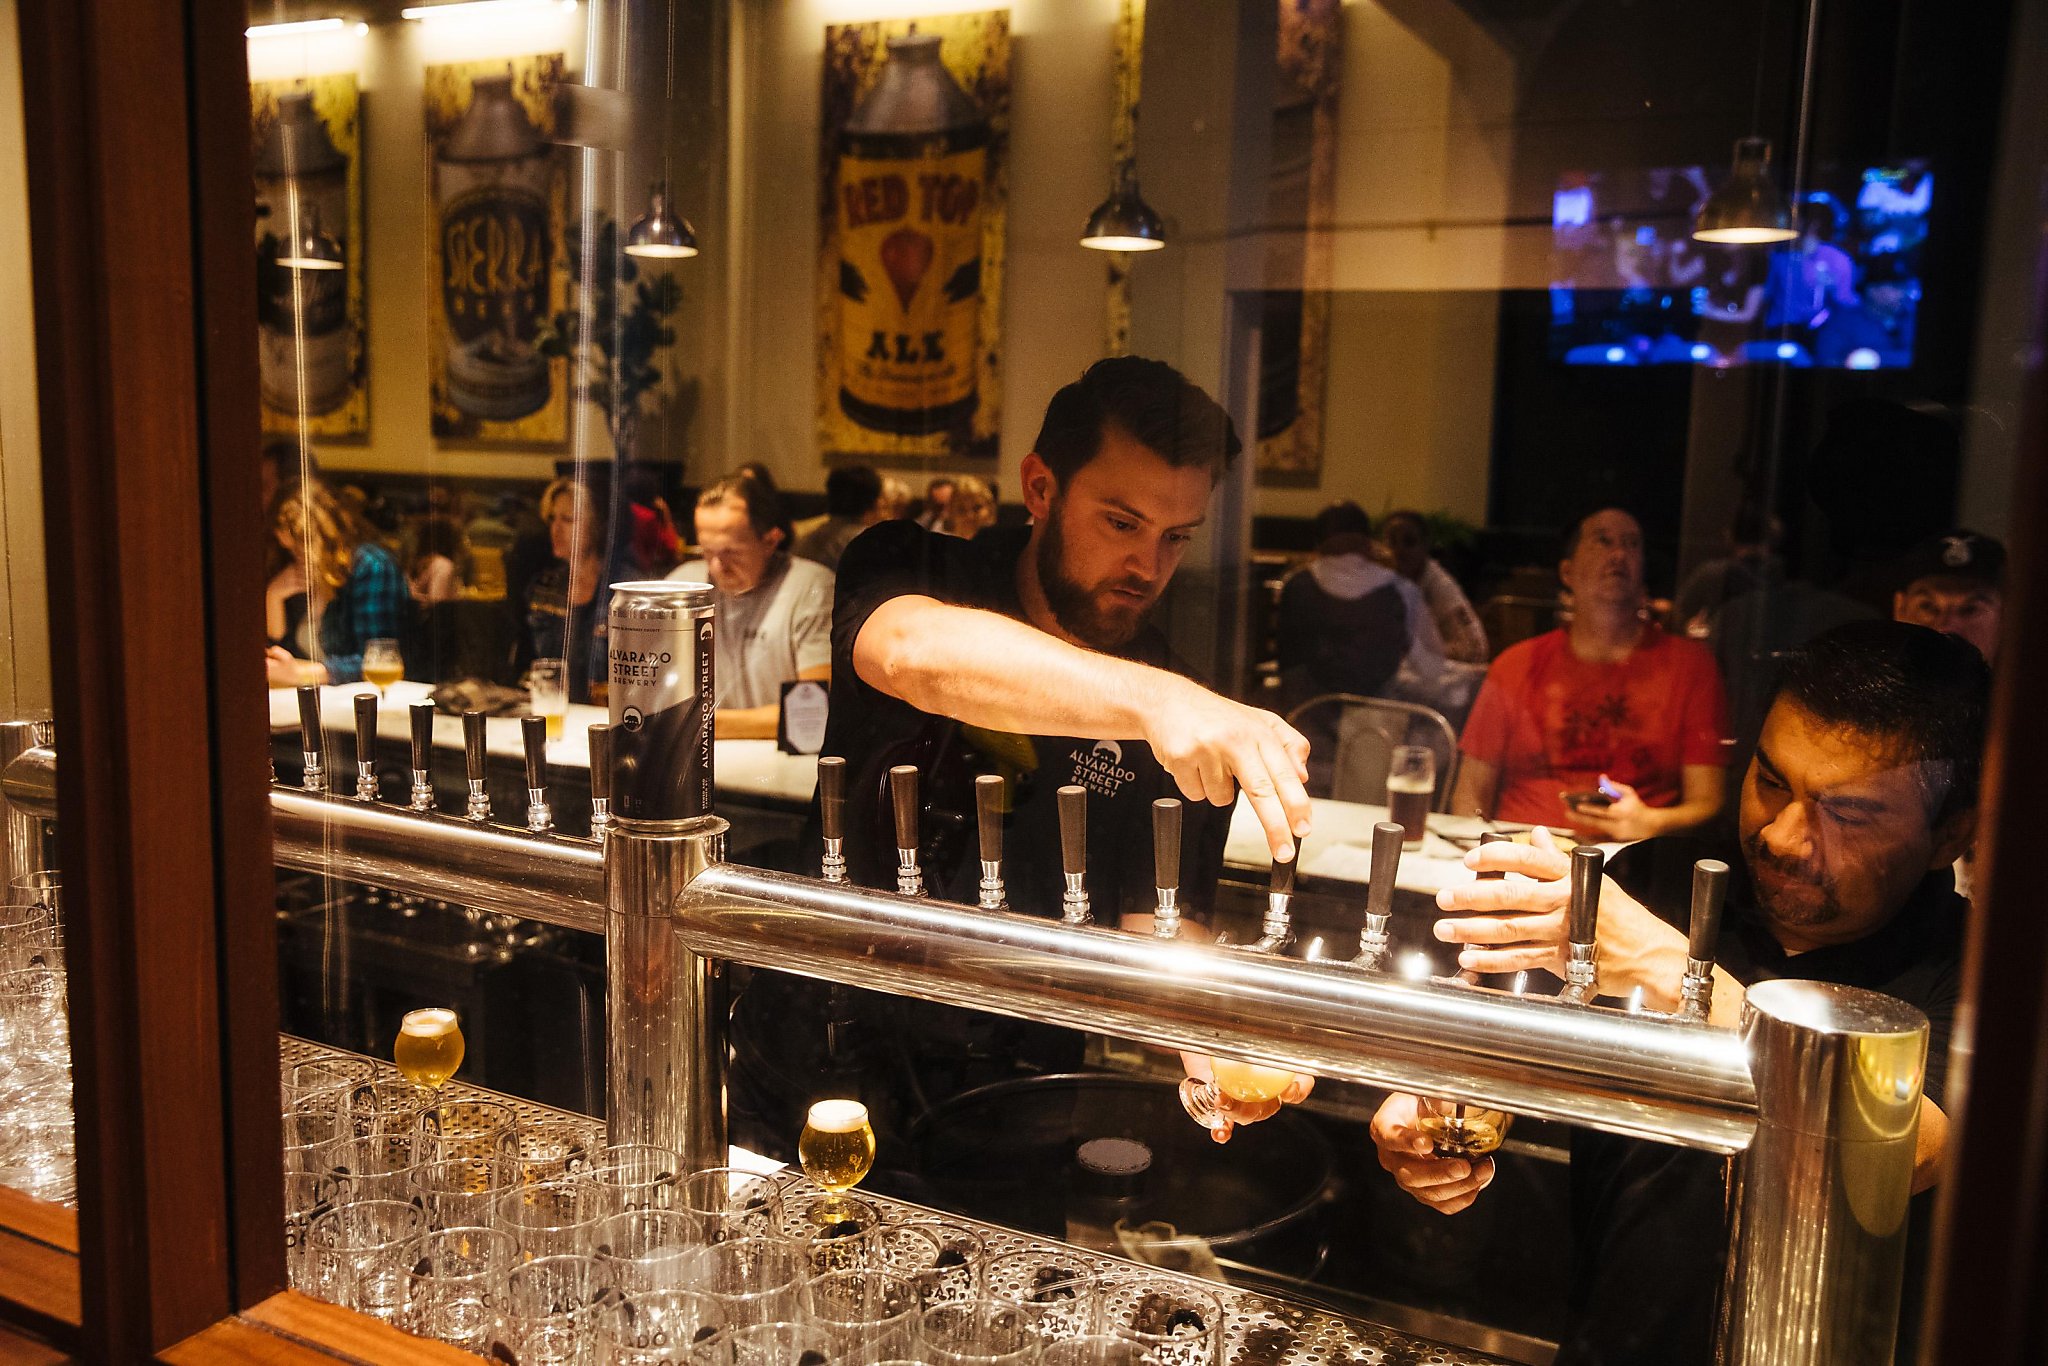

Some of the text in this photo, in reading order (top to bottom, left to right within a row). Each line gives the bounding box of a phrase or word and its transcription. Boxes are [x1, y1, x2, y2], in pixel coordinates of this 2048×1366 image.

[845, 171, 979, 229] RED TOP
[867, 330, 945, 364] ALE
[613, 663, 659, 677] STREET
[614, 677, 657, 687] BREWERY
[1069, 749, 1136, 782] ALVARADO
[1073, 765, 1122, 791] STREET
[1071, 775, 1117, 798] BREWERY
